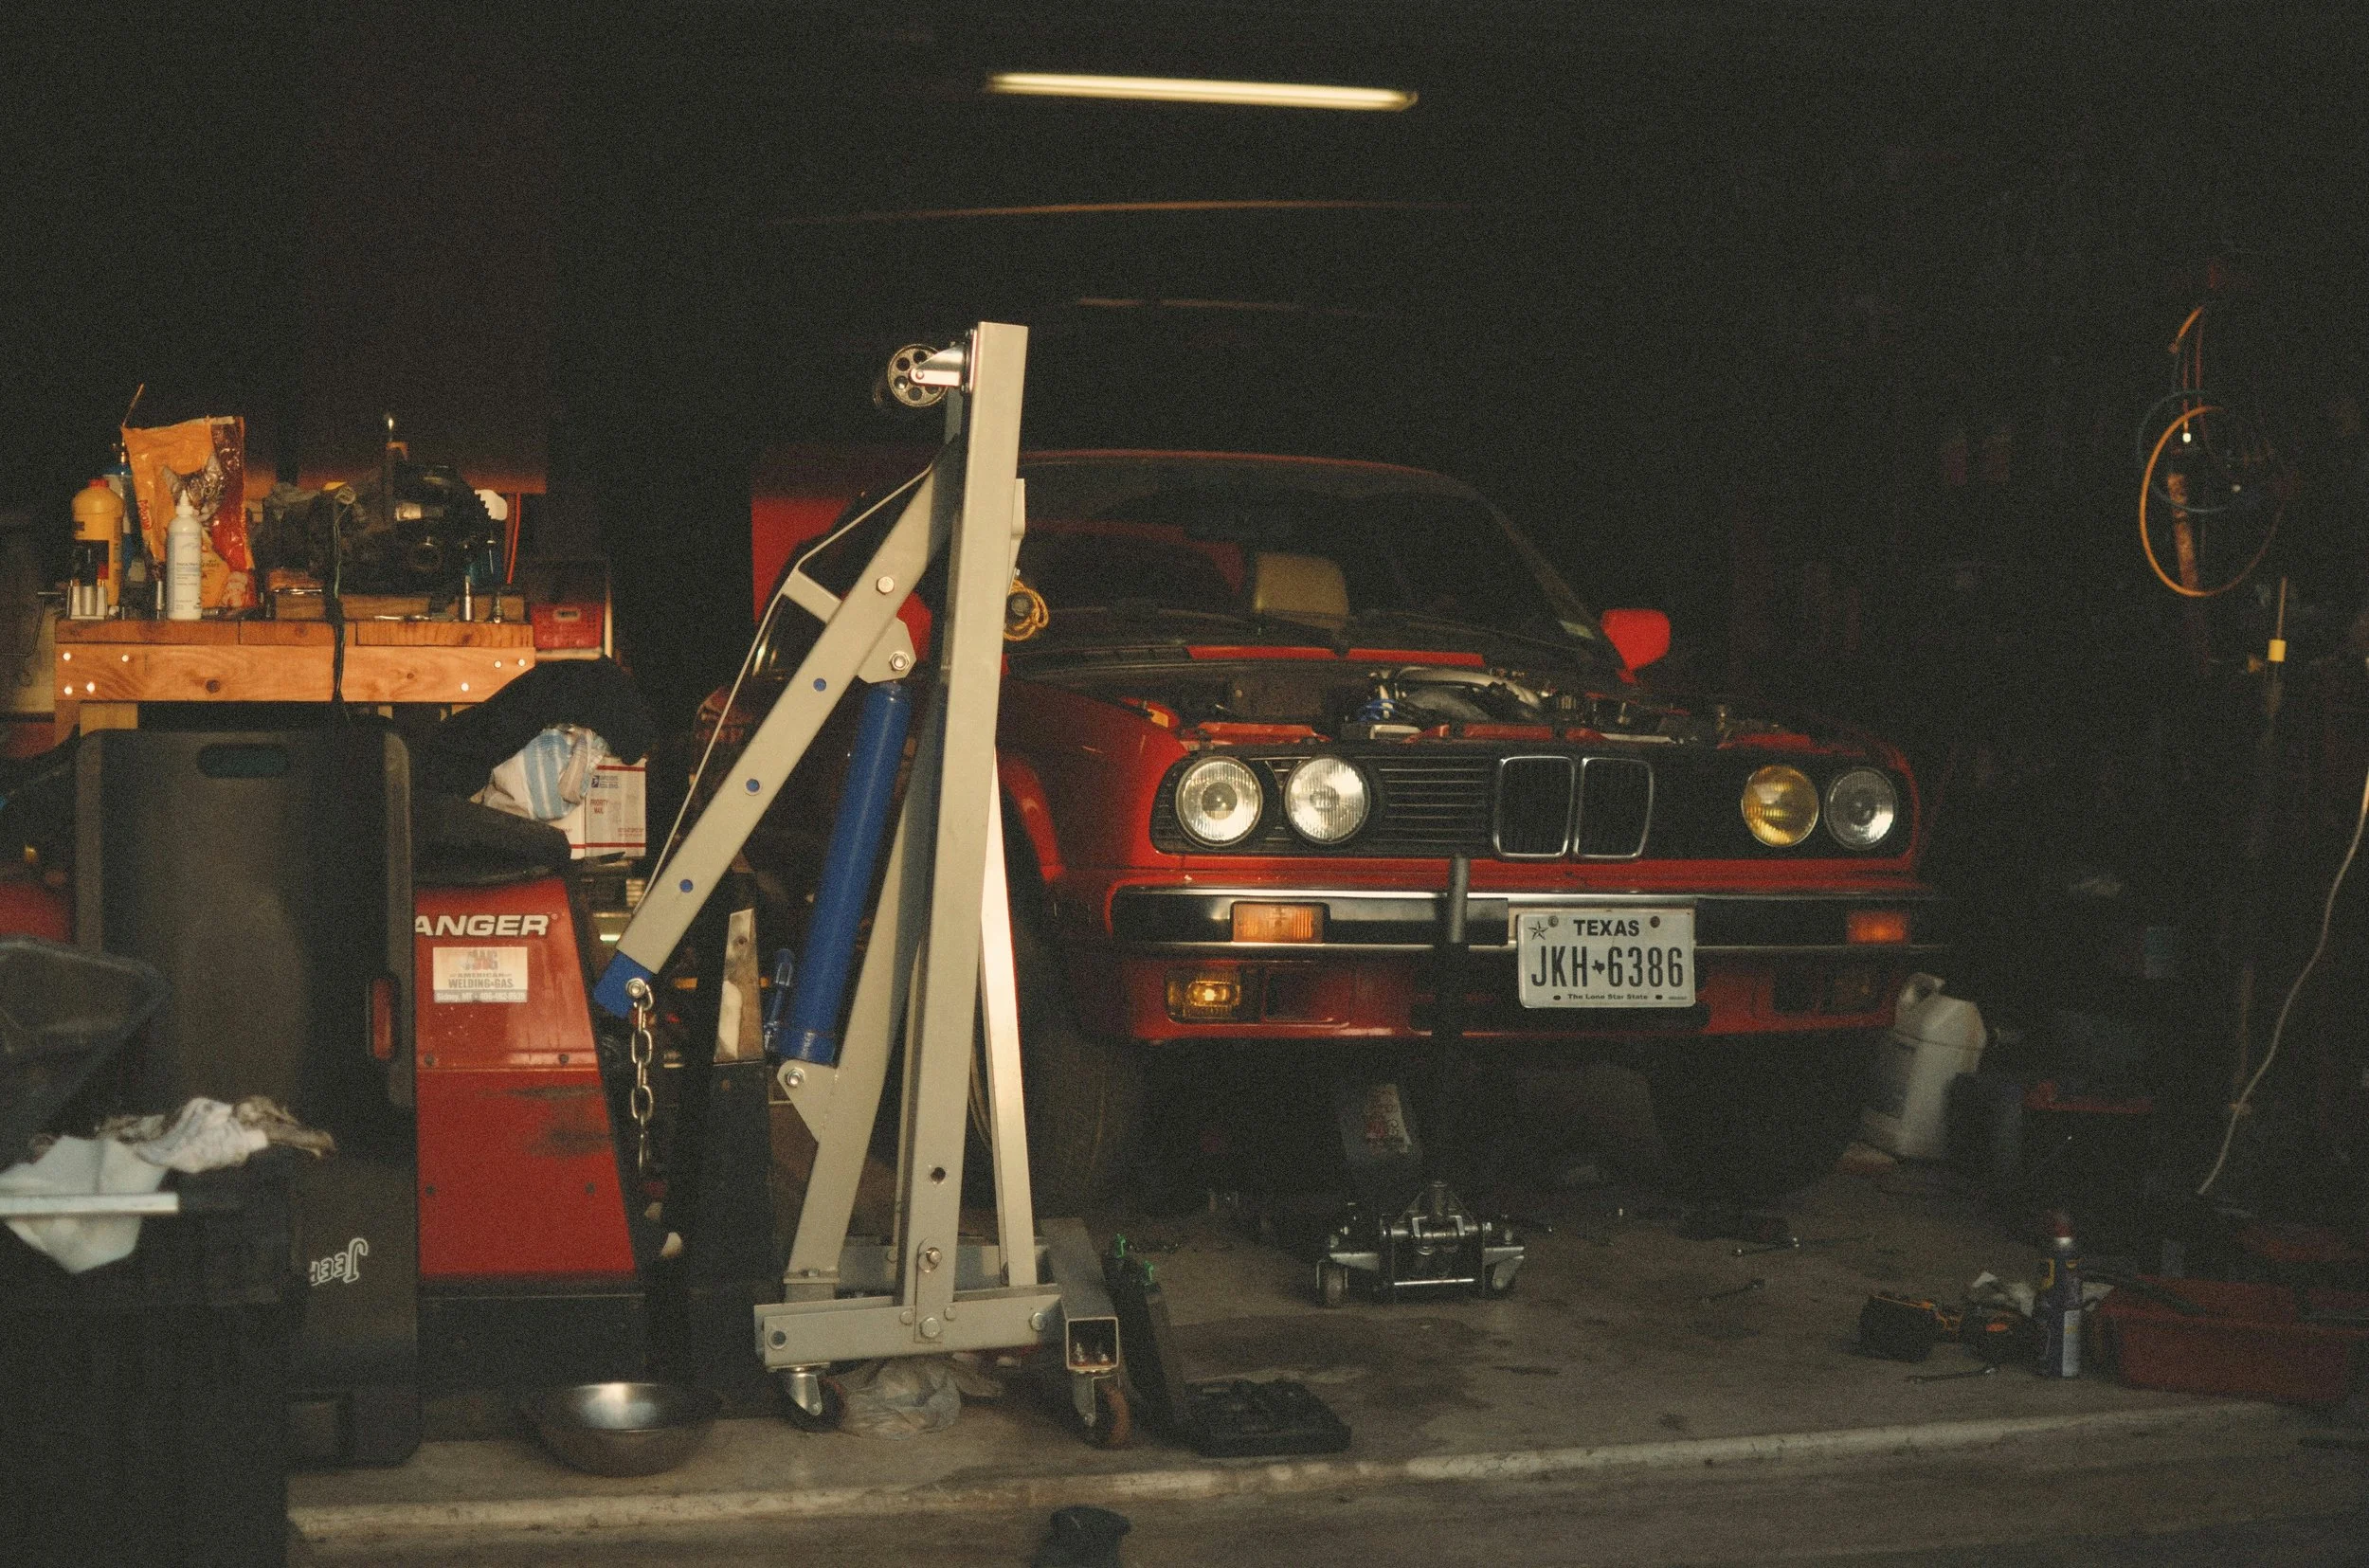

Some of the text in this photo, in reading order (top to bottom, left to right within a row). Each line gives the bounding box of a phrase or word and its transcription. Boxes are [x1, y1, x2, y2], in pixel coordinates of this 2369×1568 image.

[1573, 919, 1639, 936] TEXAS
[1531, 946, 1683, 987] JKH 6386
